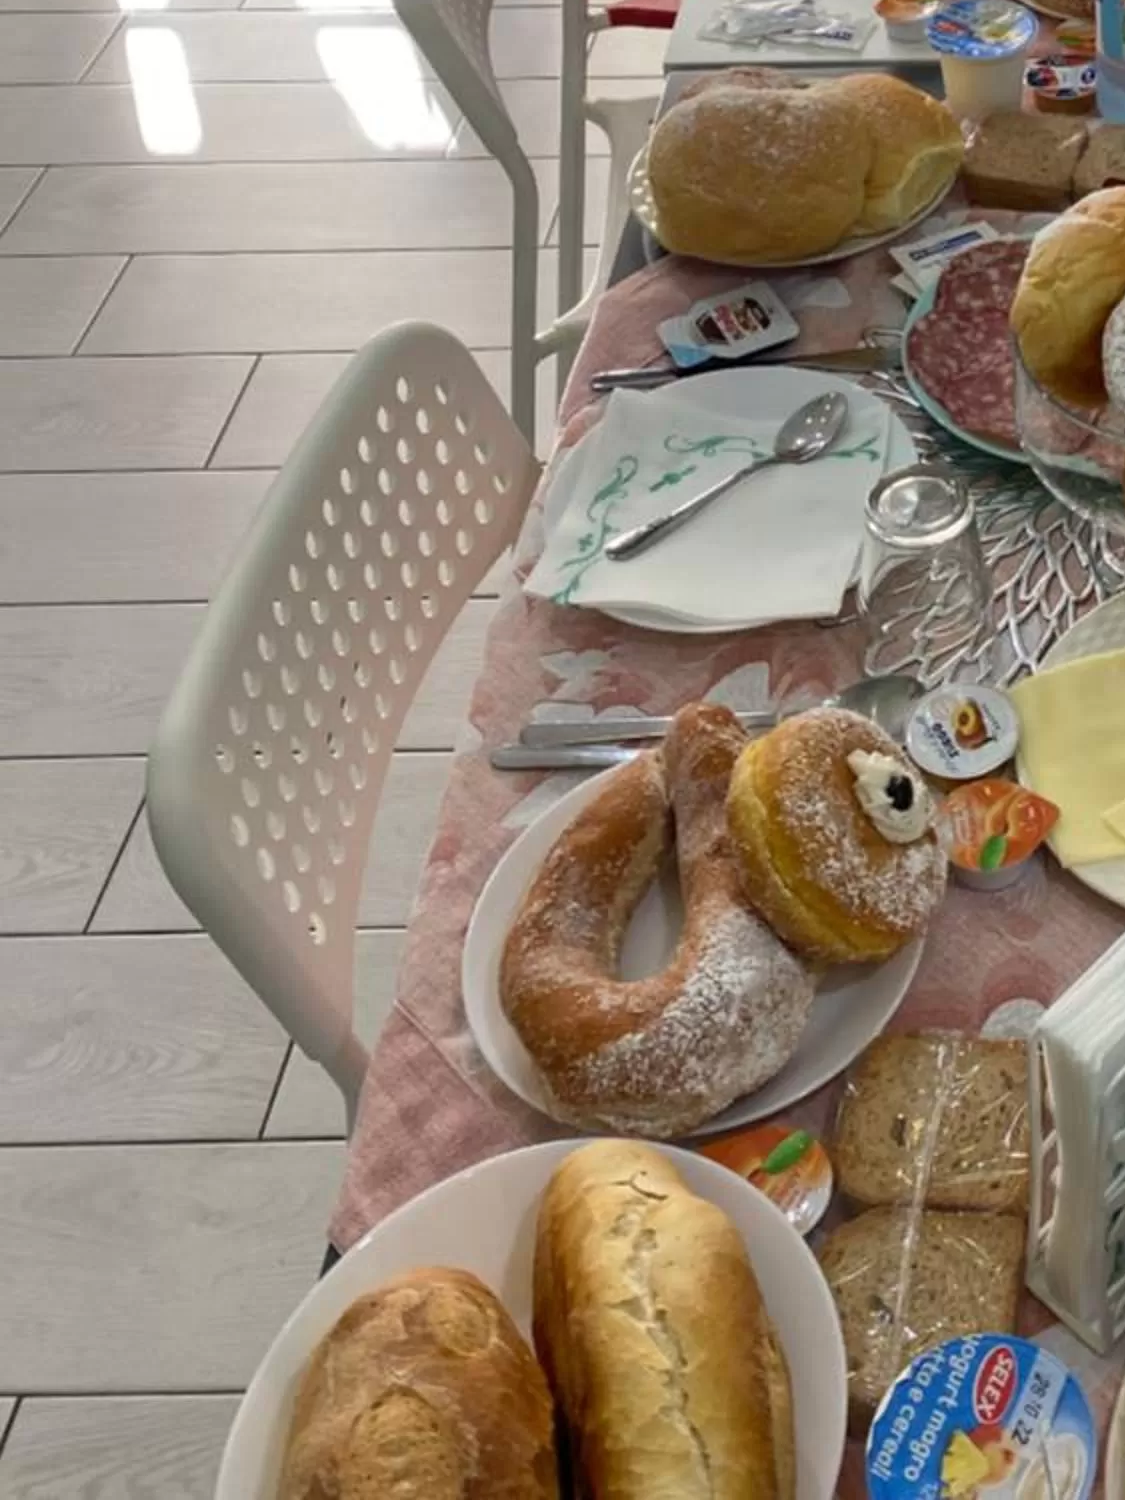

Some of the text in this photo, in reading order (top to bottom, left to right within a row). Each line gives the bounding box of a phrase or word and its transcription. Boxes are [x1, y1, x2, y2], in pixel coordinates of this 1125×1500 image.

[903, 1334, 983, 1482] yogurt magro
[908, 1387, 924, 1402] e
[977, 1353, 1014, 1418] SELEX
[870, 1405, 915, 1480] cereali
